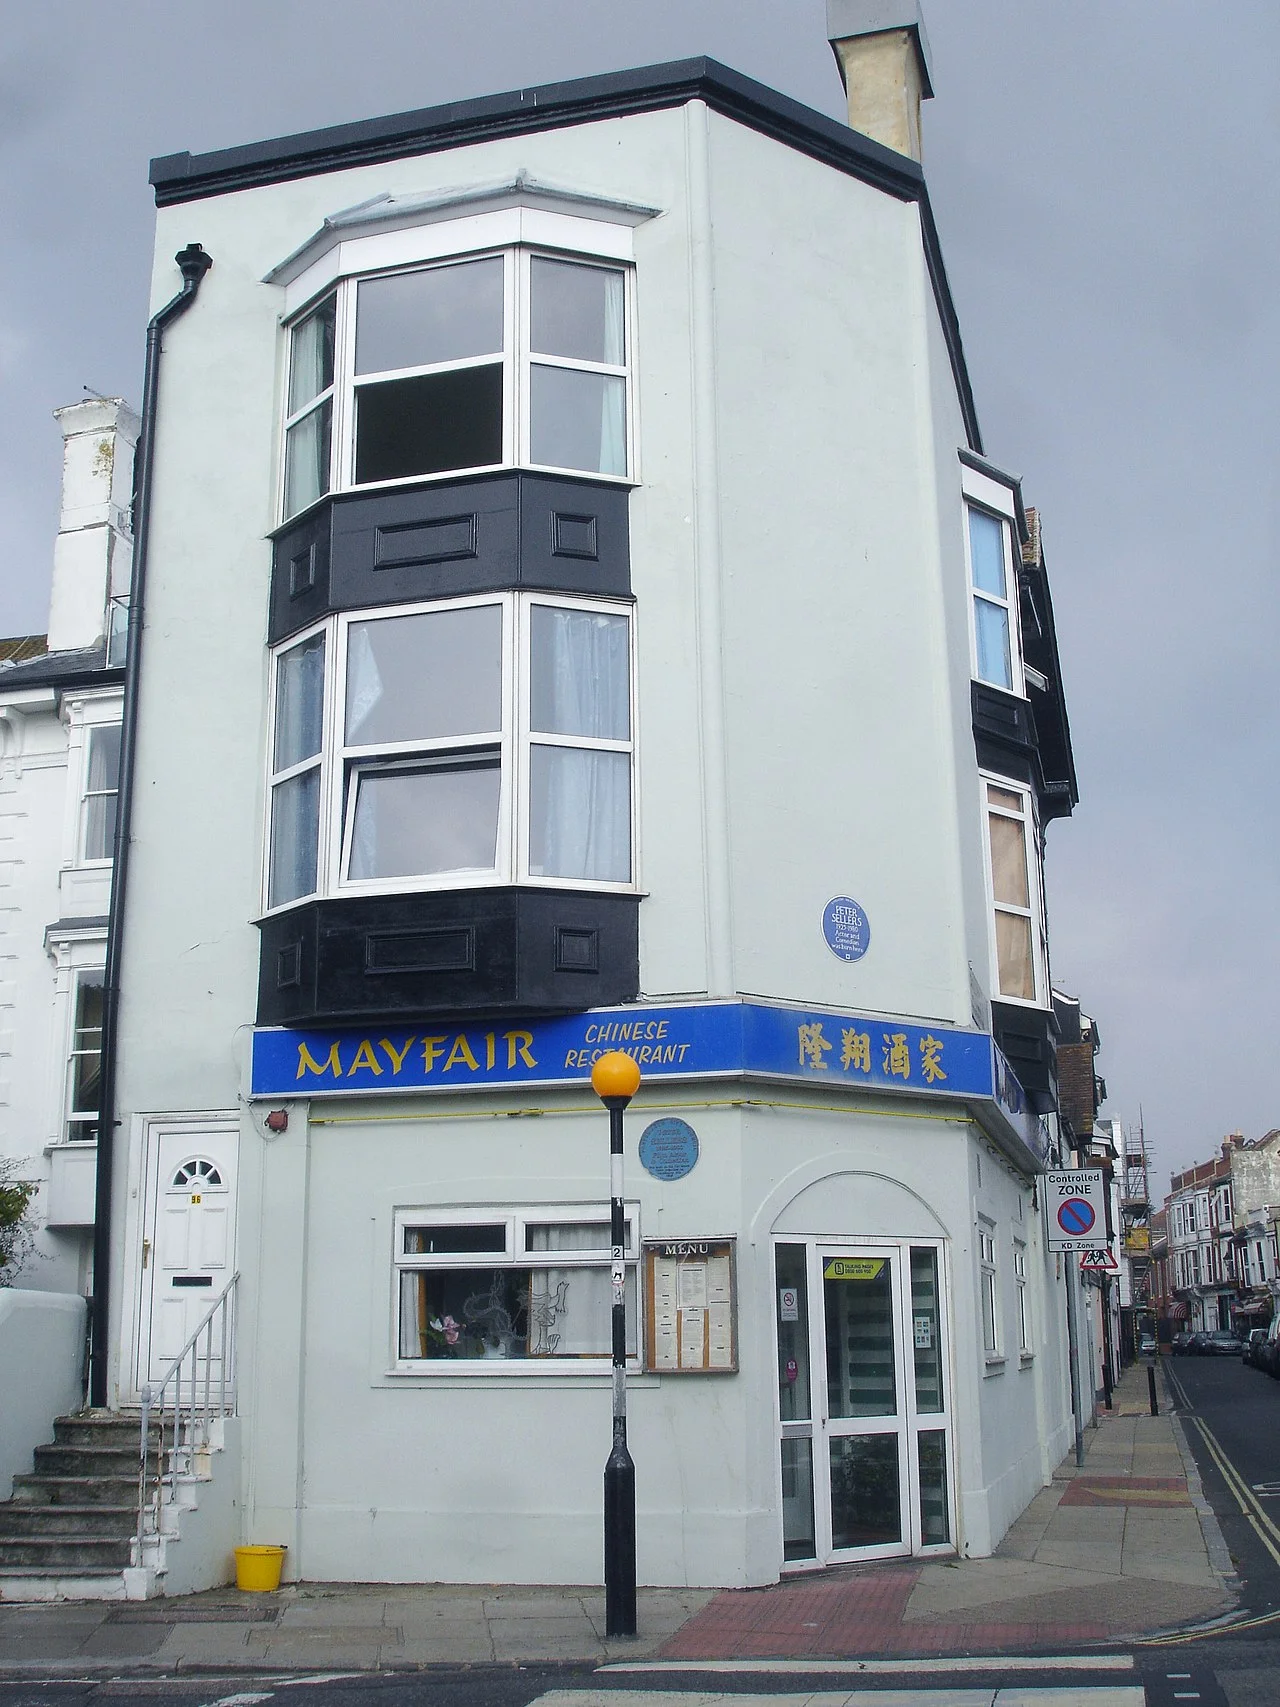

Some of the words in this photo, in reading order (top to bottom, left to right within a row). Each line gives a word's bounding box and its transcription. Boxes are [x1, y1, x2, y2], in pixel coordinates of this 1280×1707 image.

[836, 906, 857, 917] PETER
[832, 914, 862, 927] SELLERS
[585, 1021, 670, 1043] CHINESE
[296, 1030, 539, 1080] MAYFAIR
[797, 1022, 948, 1084] 隆翔酒家
[1049, 1174, 1099, 1183] Controlled
[1058, 1185, 1091, 1195] ZONE
[614, 1248, 620, 1257] 2
[665, 1243, 708, 1255] MENU
